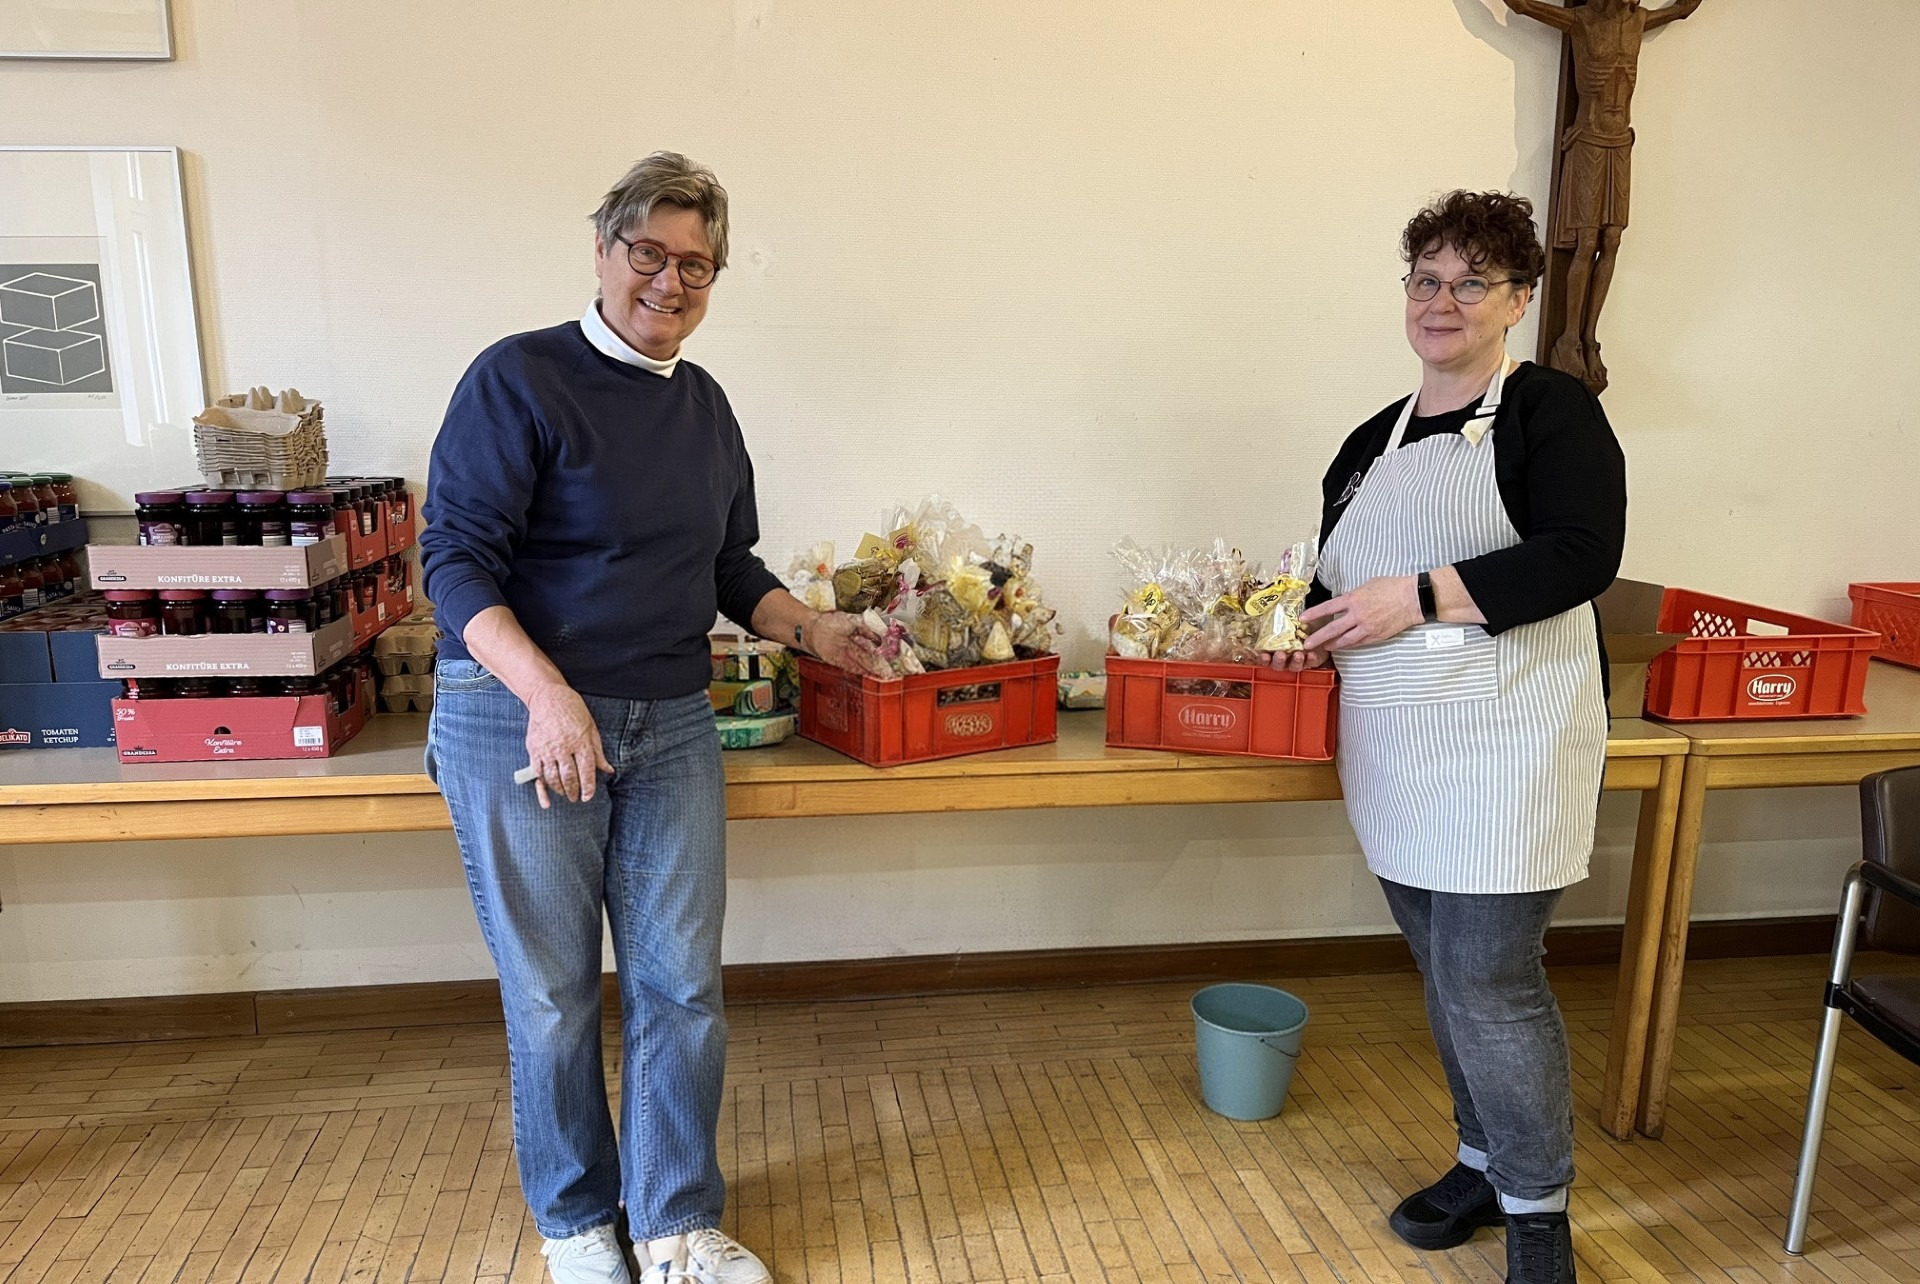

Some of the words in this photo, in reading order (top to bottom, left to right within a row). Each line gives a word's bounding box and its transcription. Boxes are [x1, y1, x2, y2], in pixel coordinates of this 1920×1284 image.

[157, 574, 210, 583] KONFITÜRE
[212, 575, 242, 583] EXTRA
[166, 661, 218, 671] KONFITÜRE
[220, 662, 249, 670] EXTRA
[1752, 680, 1792, 695] Harry
[1183, 708, 1230, 728] Harry
[41, 728, 79, 736] TOMATEN
[44, 736, 79, 744] KETCHUP
